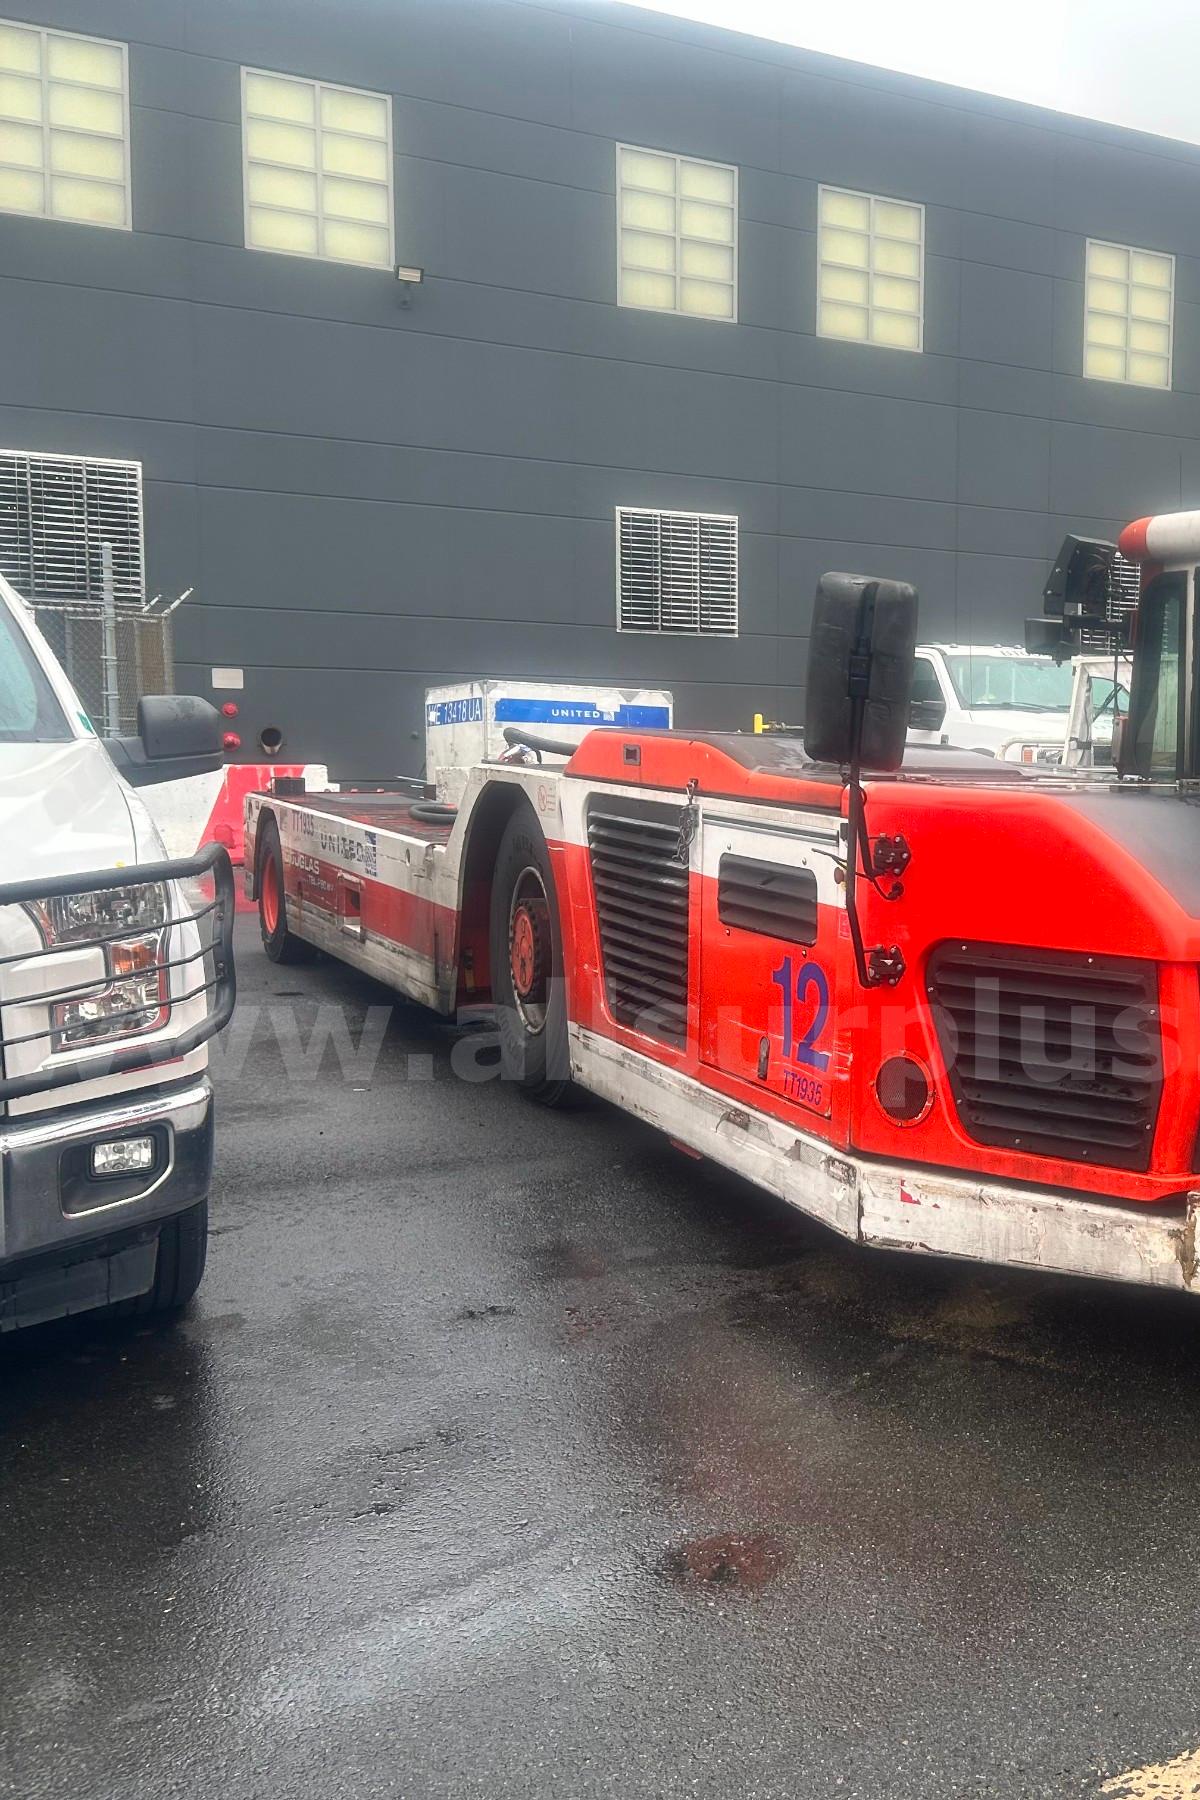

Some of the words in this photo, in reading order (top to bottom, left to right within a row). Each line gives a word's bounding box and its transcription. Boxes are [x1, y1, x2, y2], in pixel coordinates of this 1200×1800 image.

[551, 709, 600, 719] UNITED
[773, 956, 830, 1072] 12
[783, 1069, 823, 1105] TT1935
